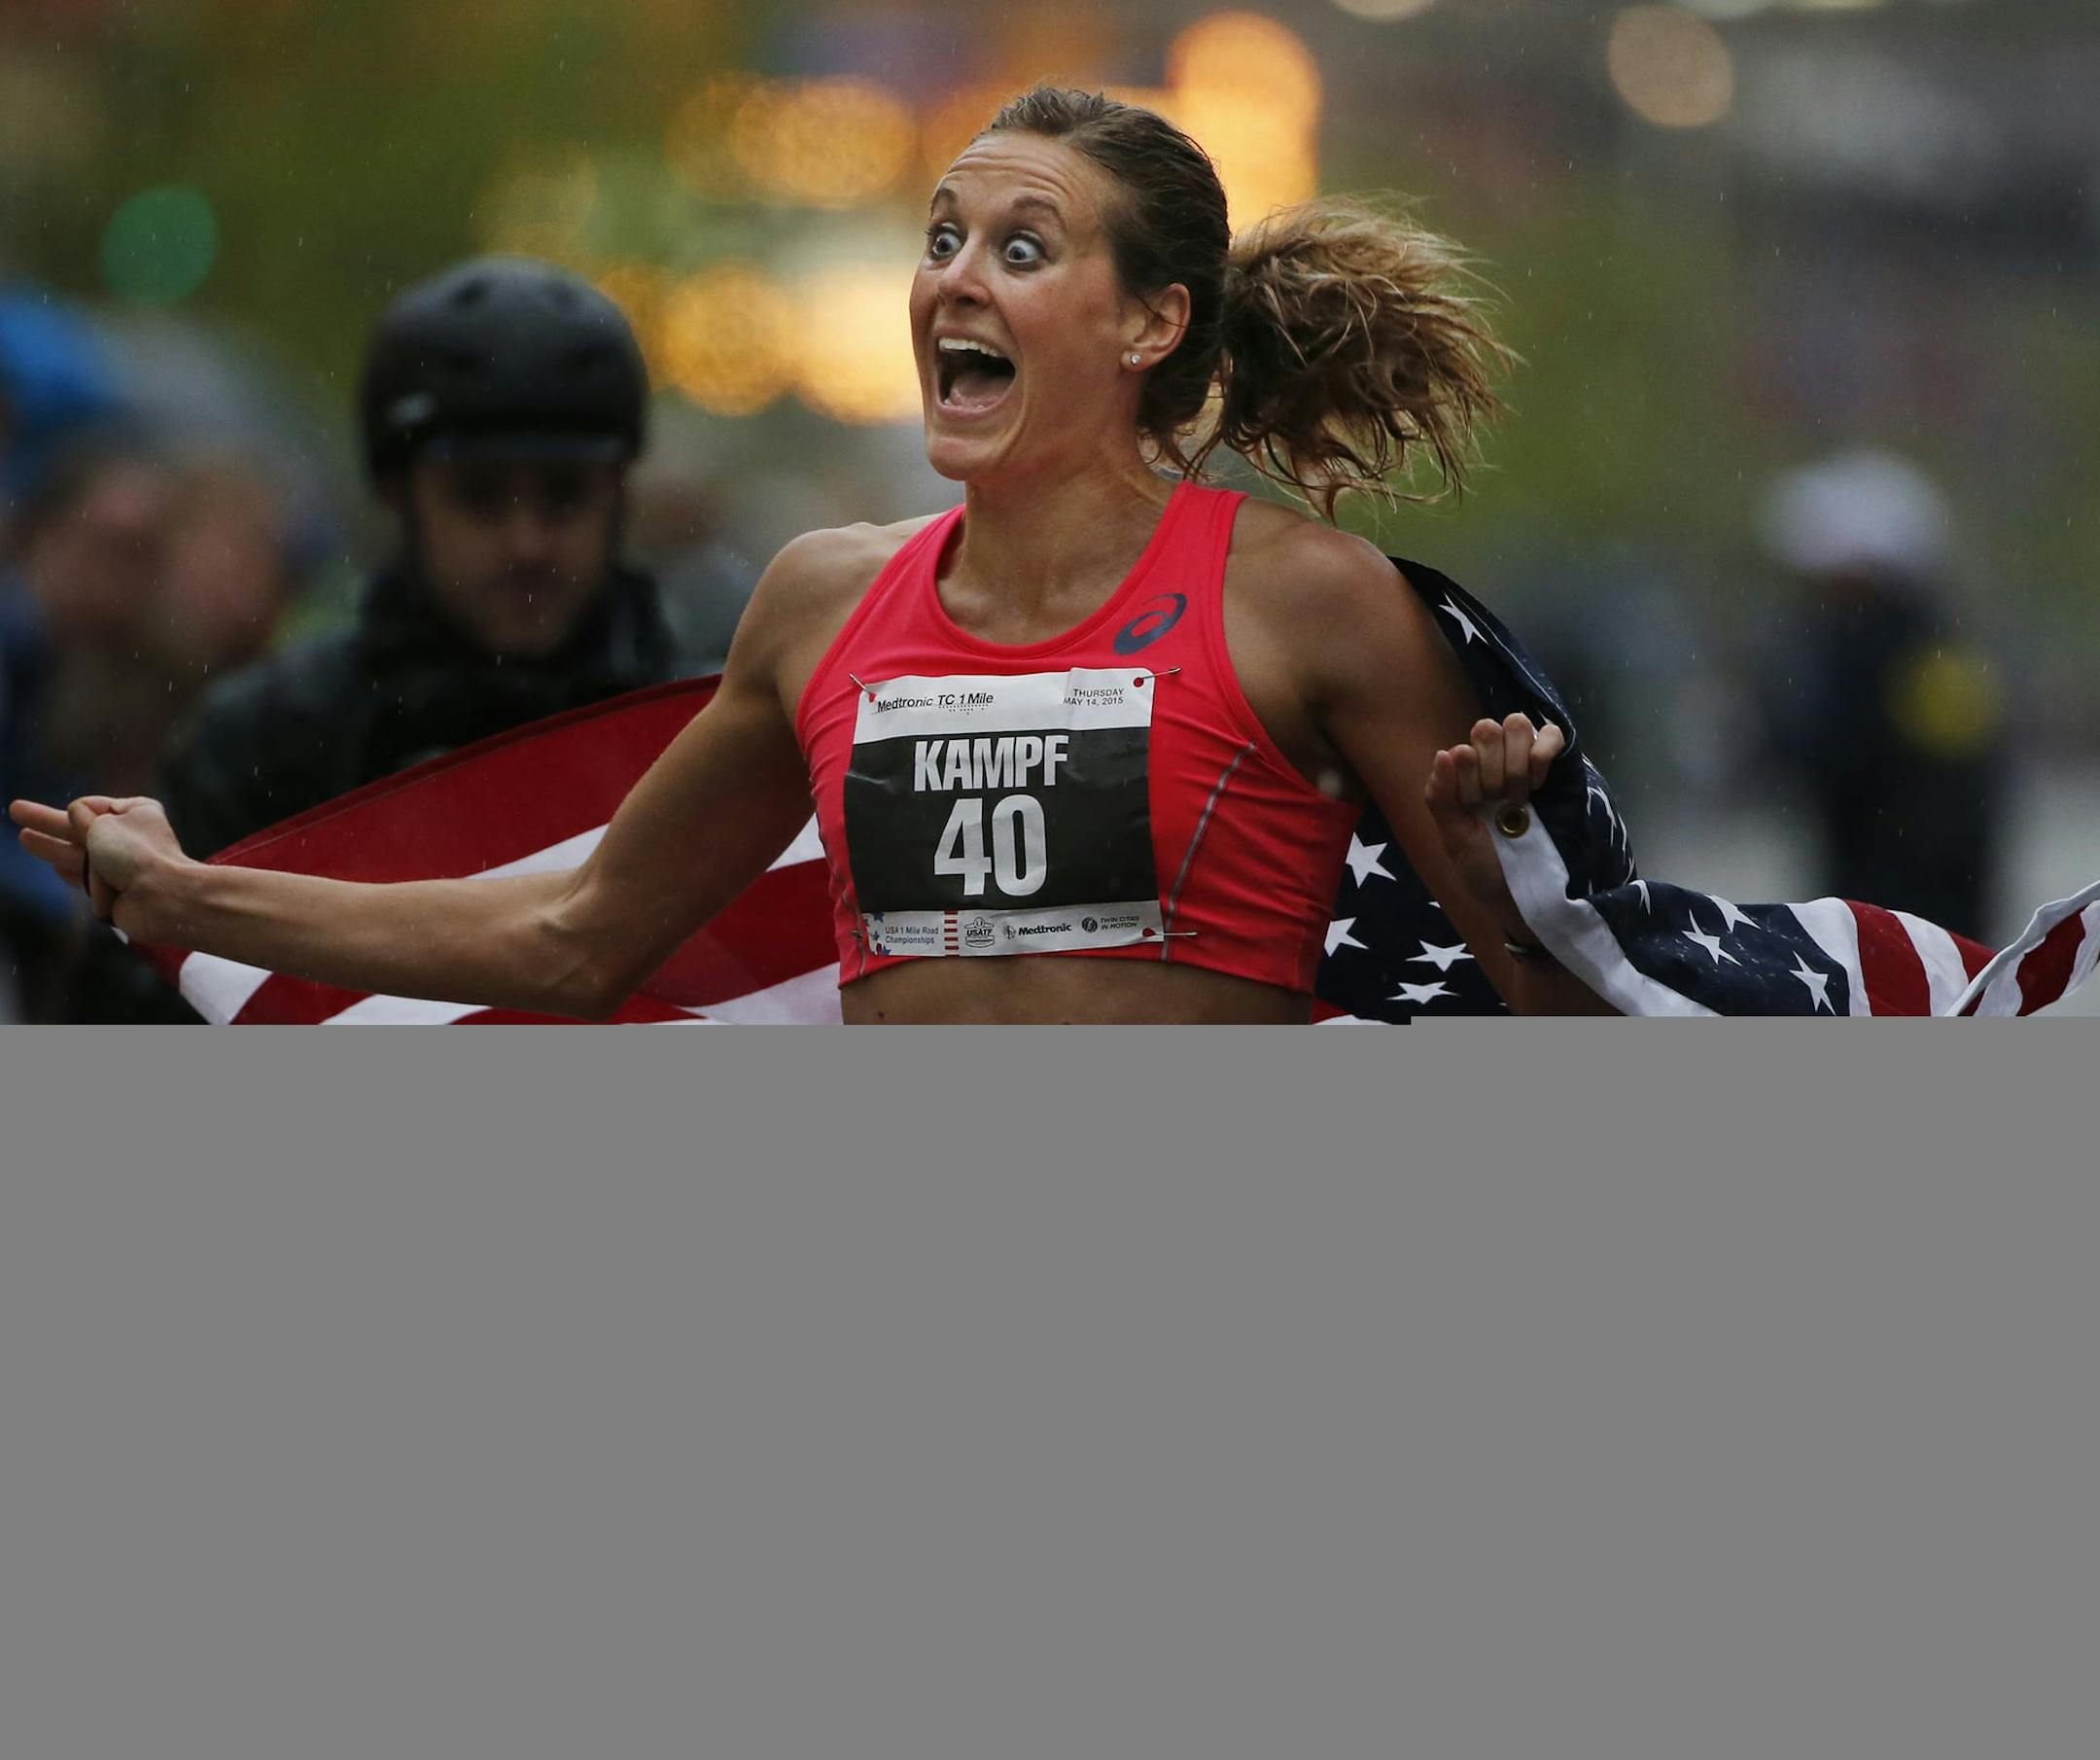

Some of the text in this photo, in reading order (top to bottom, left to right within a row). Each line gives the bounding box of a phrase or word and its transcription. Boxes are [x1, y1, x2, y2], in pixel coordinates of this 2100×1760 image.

[1073, 688, 1124, 697] THURSDAY
[877, 692, 994, 713] Medtronic TC 1 Mile
[1064, 697, 1082, 706] MAY
[914, 735, 1069, 792] KAMPF
[933, 793, 1048, 897] 40
[1019, 923, 1072, 935] Medtronic
[885, 935, 934, 944] Championships
